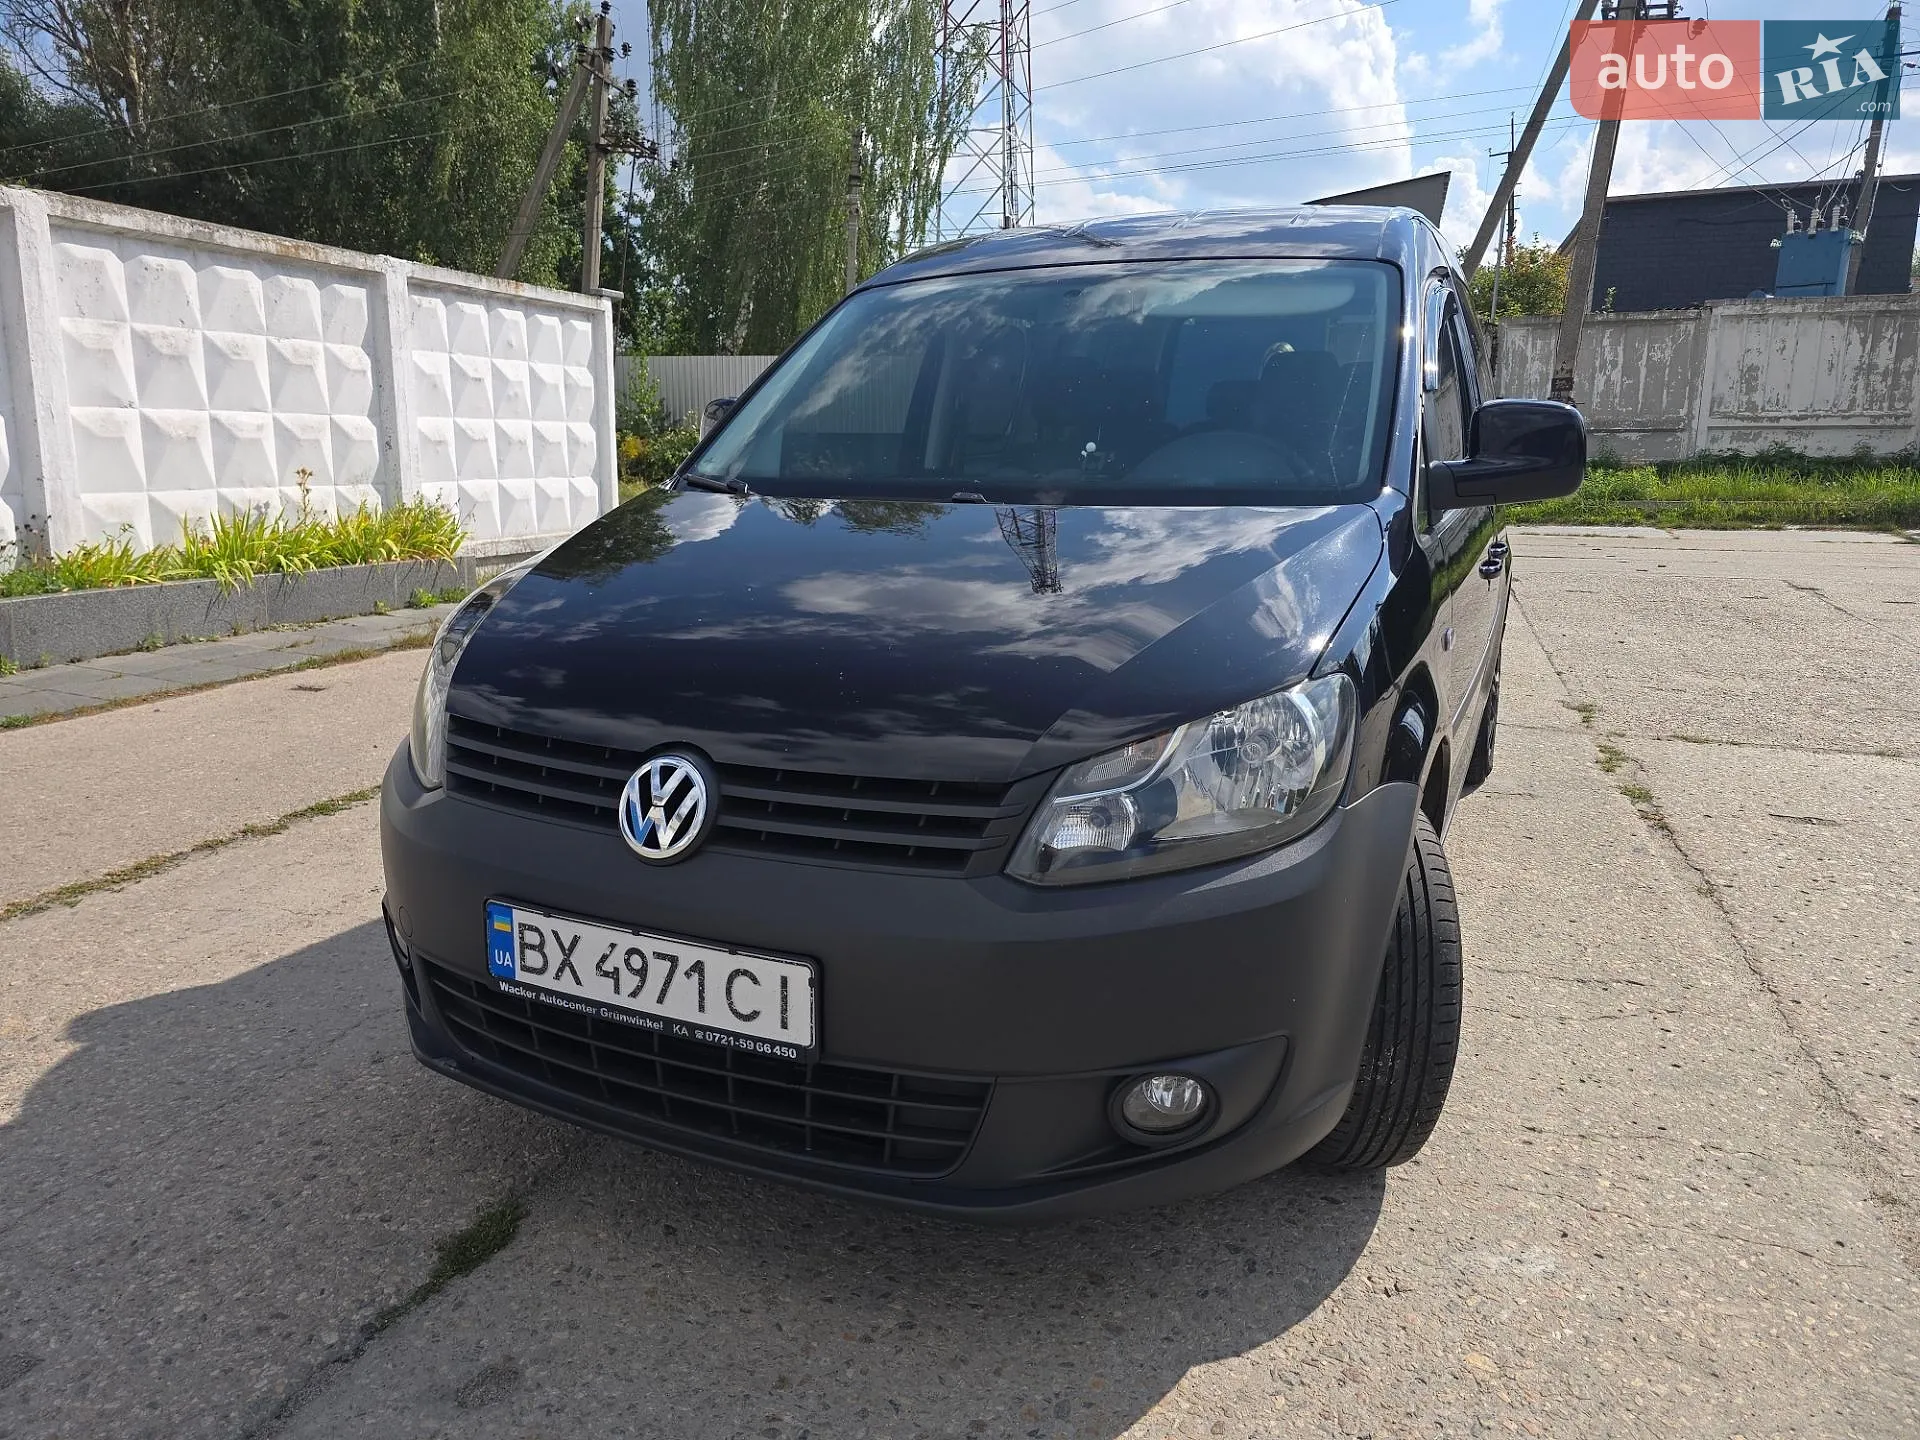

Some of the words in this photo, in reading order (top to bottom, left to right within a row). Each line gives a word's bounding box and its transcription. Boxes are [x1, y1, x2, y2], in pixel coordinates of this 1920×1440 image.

[495, 949, 513, 968] UA
[518, 922, 583, 987] BX
[595, 942, 706, 1014] 4971
[725, 968, 790, 1031] CI
[499, 980, 537, 1000] Wacker
[539, 992, 597, 1015] Autocenter
[673, 1023, 689, 1037] KA
